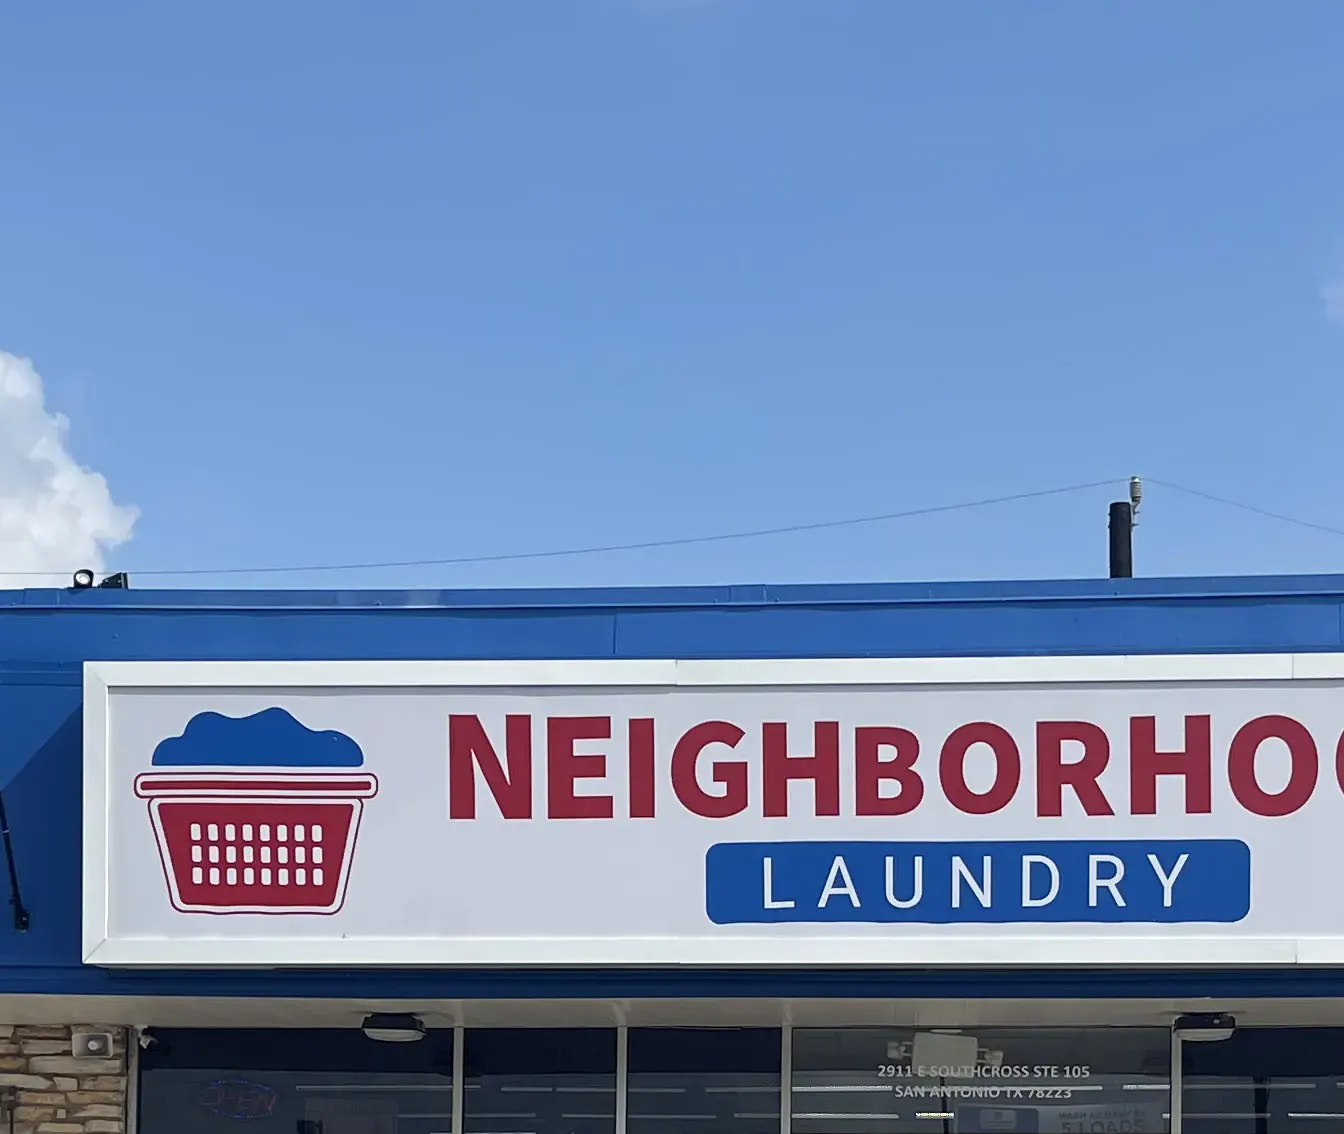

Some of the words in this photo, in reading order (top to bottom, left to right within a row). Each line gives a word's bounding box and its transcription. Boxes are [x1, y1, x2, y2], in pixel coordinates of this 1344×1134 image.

[763, 853, 1190, 909] LAUNDRY
[877, 1064, 913, 1078] 2911
[918, 1065, 926, 1077] E
[928, 1065, 1031, 1079] SOUTHCROSS
[1033, 1065, 1059, 1078] STE
[1063, 1065, 1091, 1079] 105
[894, 1085, 926, 1098] SAN
[930, 1085, 1001, 1098] ANTONIO
[1005, 1085, 1023, 1099] TX
[1027, 1085, 1072, 1099] 78223
